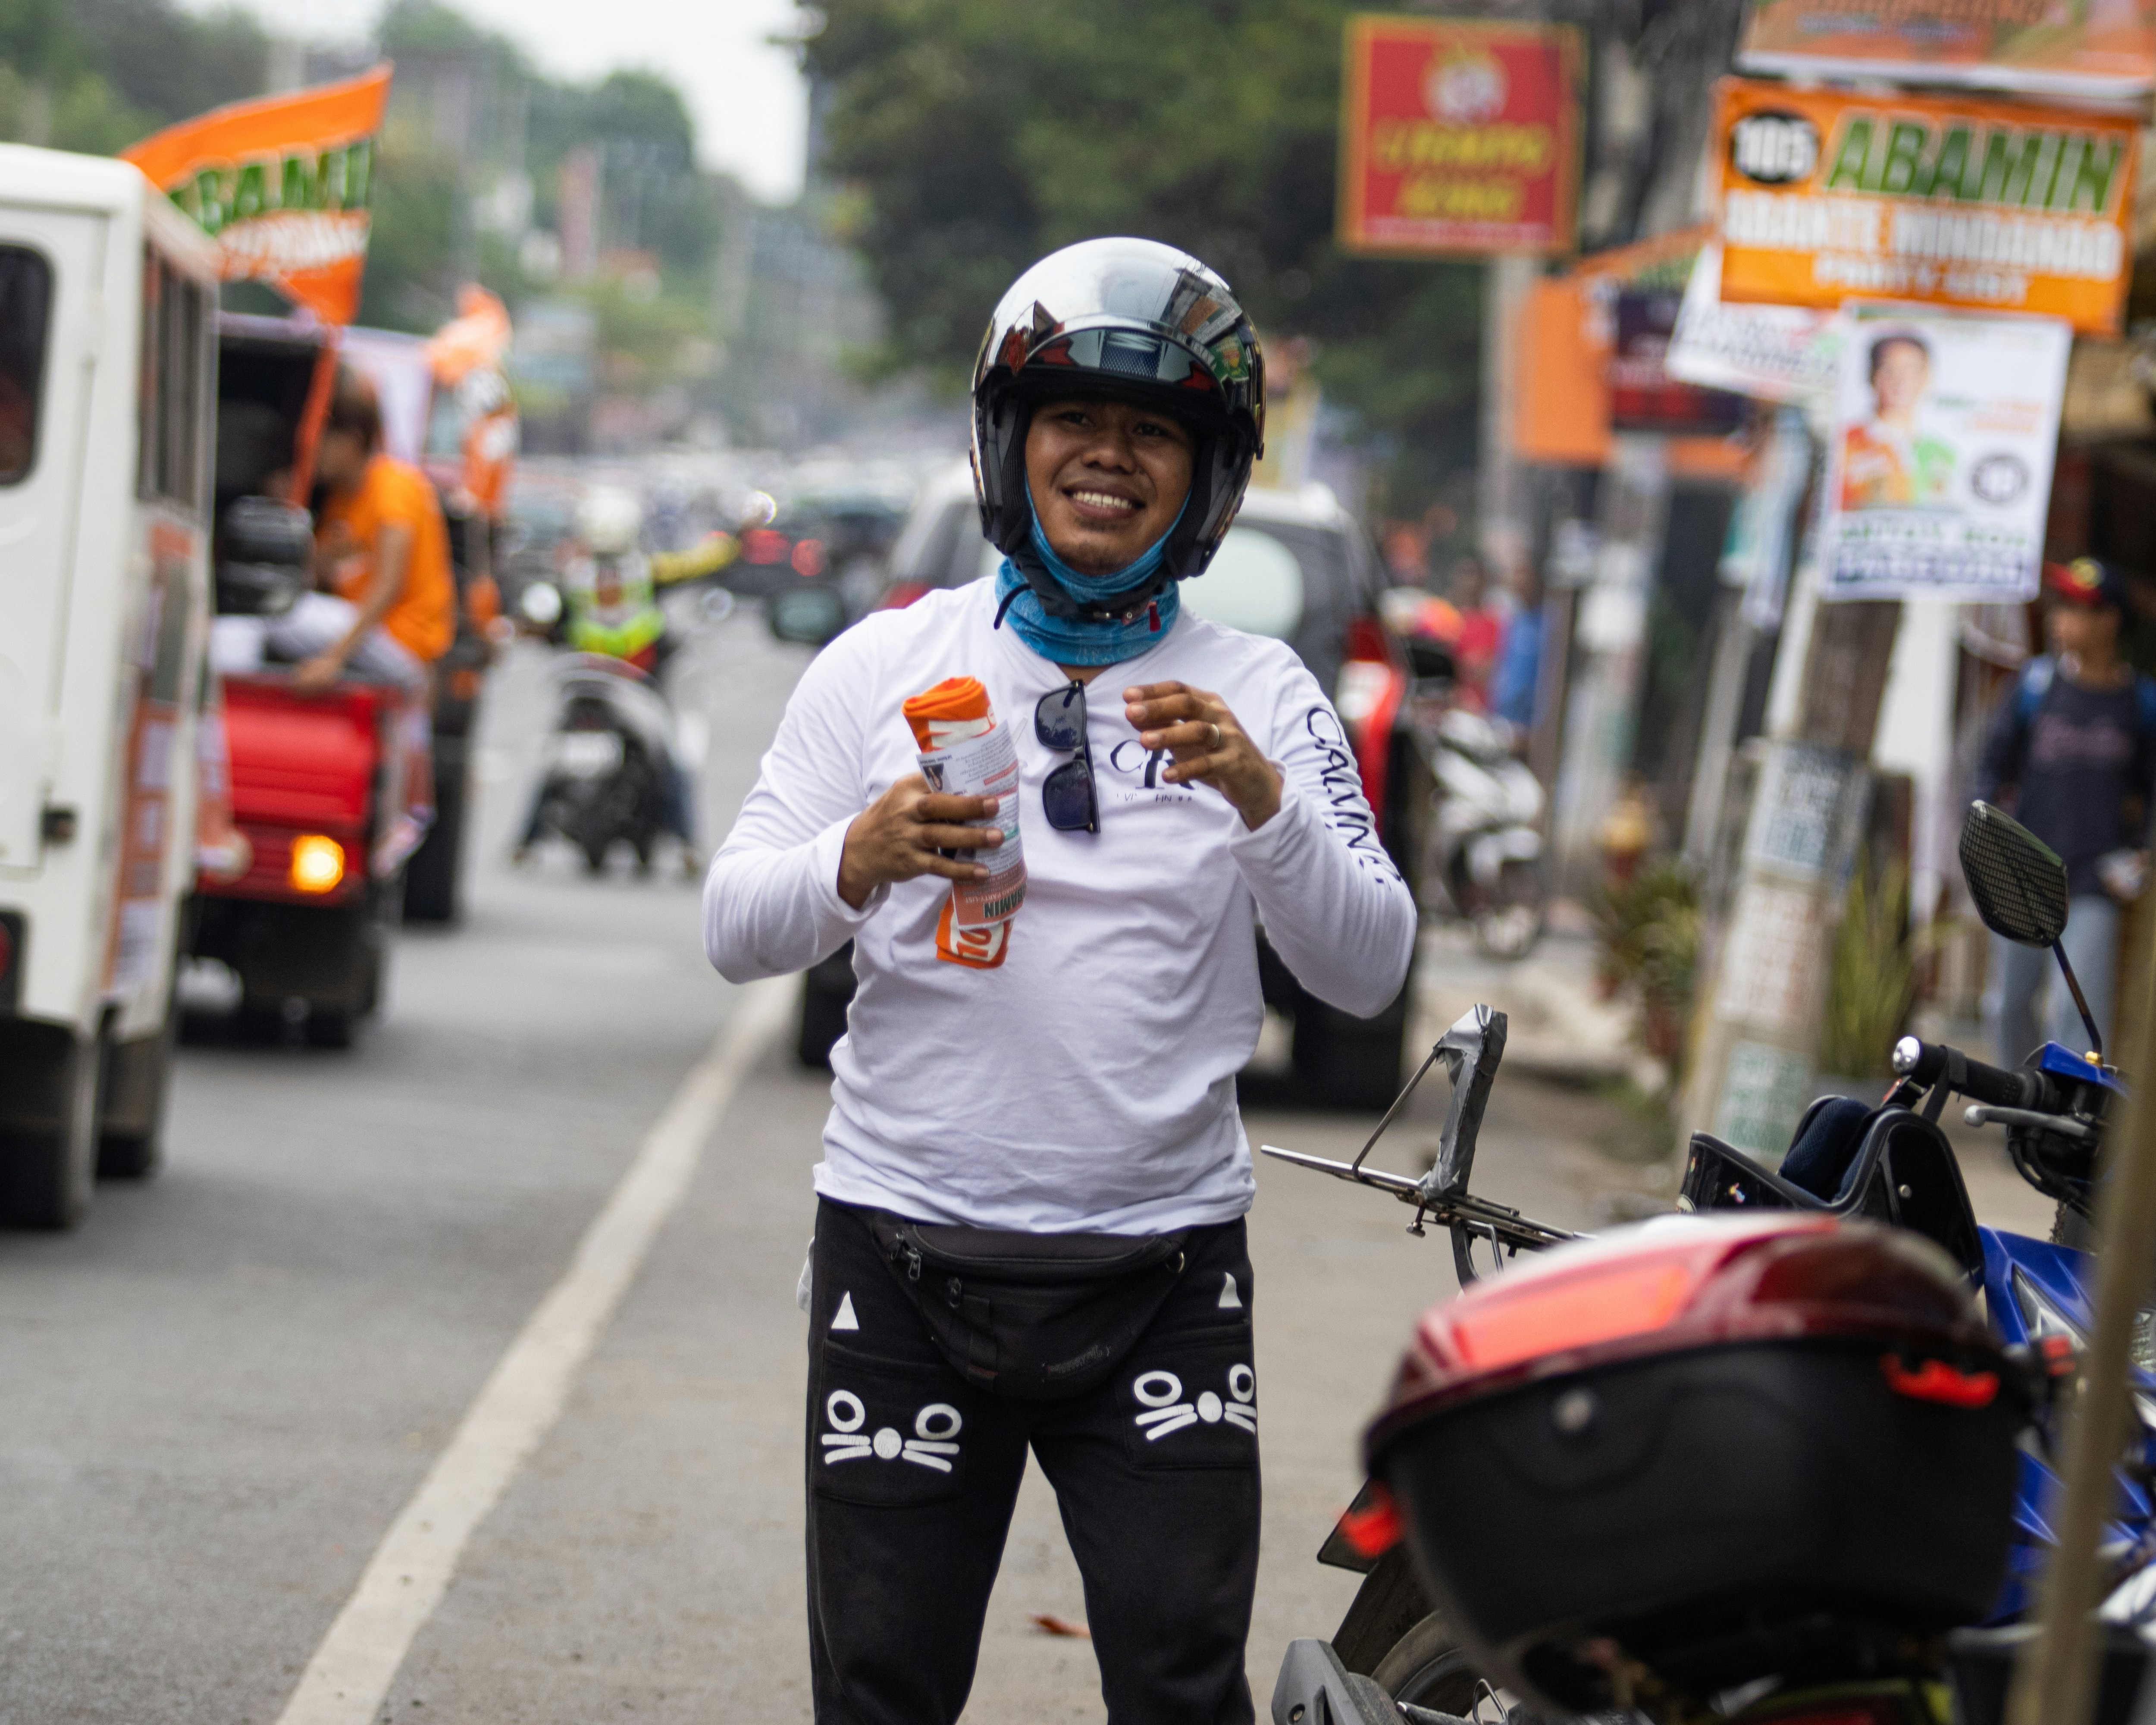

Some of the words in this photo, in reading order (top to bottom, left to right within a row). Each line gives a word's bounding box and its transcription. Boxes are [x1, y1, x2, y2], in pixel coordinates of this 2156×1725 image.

[1826, 114, 2125, 214] ABAMIN
[1307, 706, 1381, 853] CALVIN
[984, 884, 1025, 918] BAMIN
